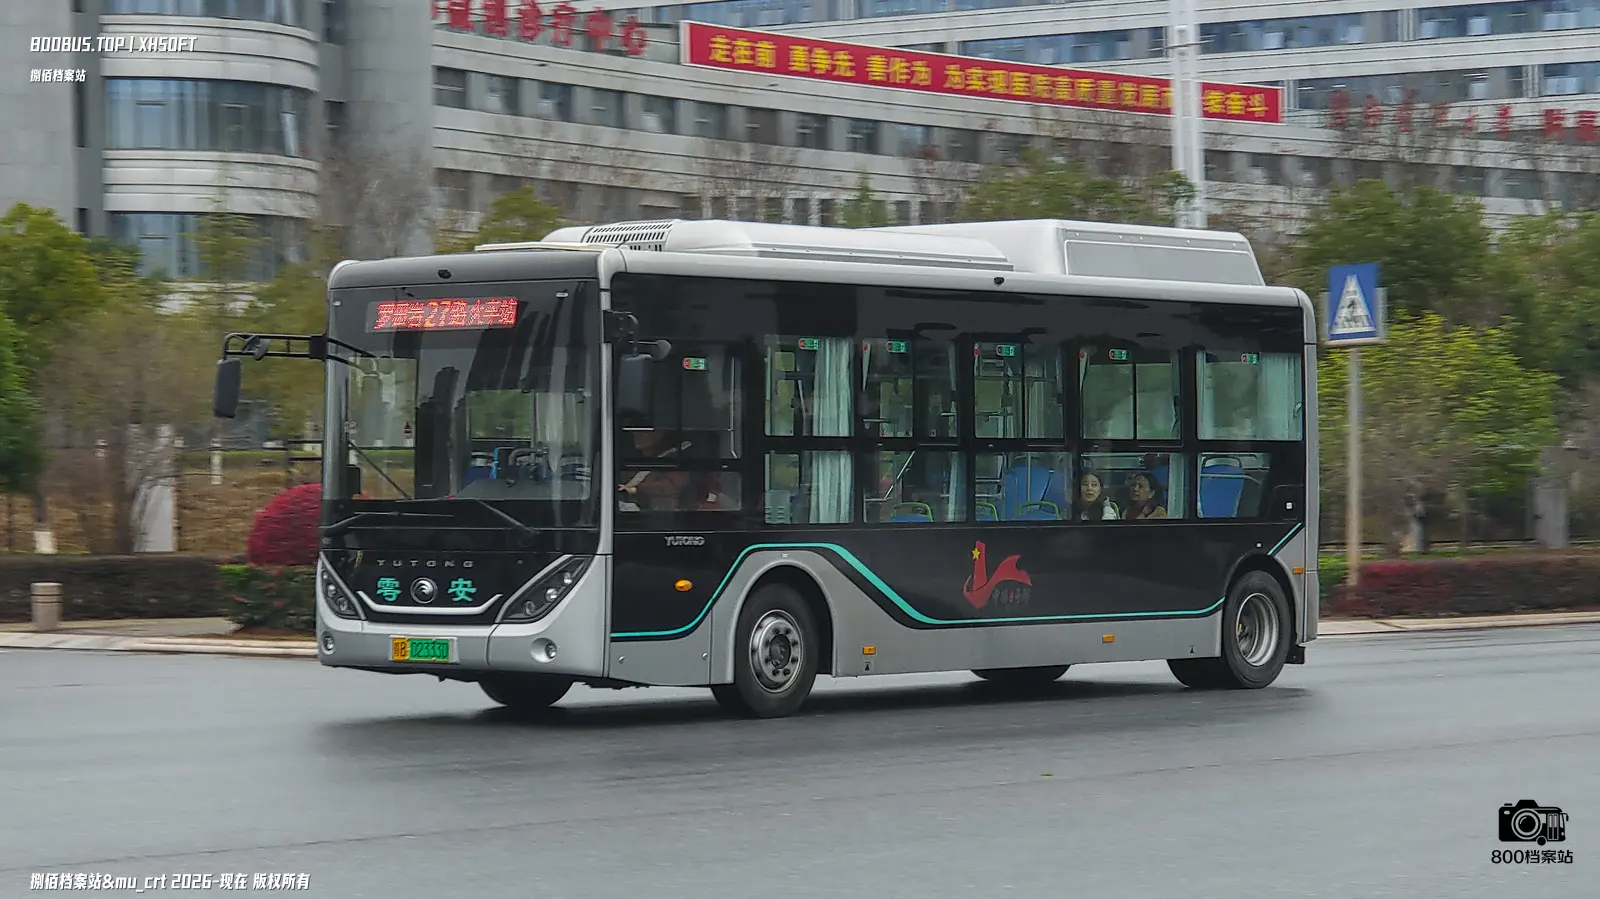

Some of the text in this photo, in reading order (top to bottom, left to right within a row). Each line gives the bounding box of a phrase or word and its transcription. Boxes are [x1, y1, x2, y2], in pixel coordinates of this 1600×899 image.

[664, 535, 706, 547] YUTONG
[376, 559, 474, 568] YUTONG
[447, 577, 477, 602] 安
